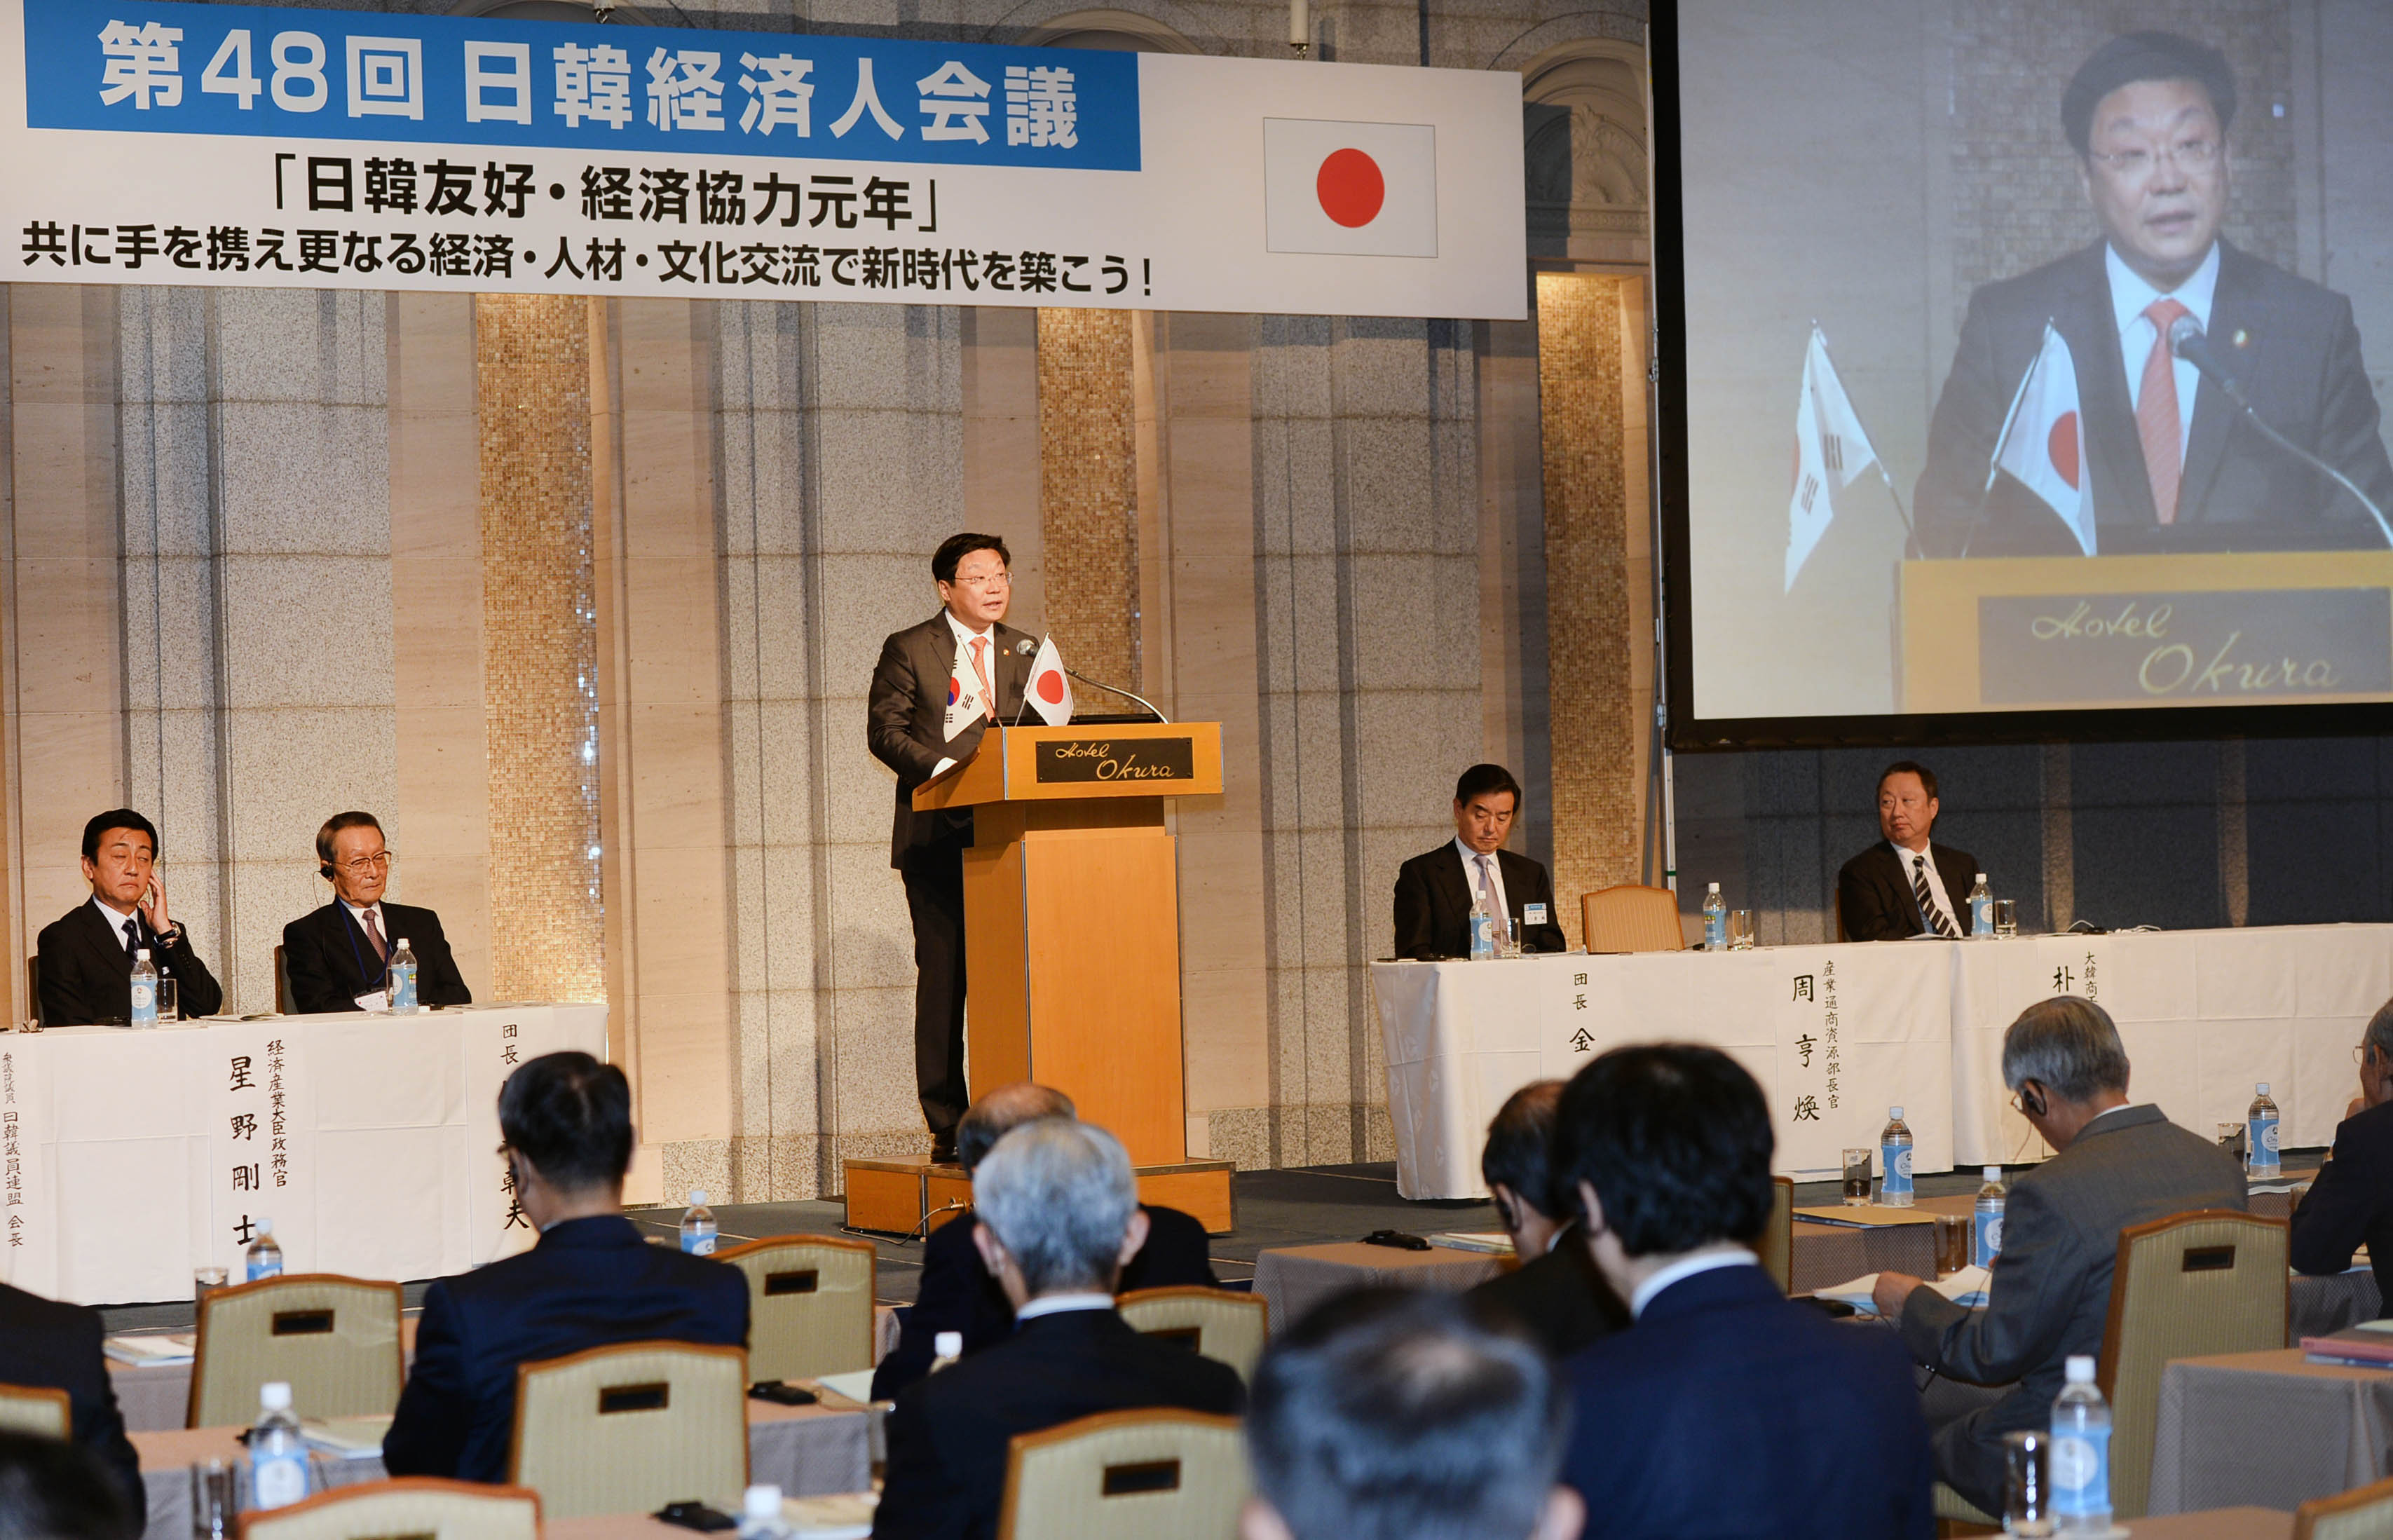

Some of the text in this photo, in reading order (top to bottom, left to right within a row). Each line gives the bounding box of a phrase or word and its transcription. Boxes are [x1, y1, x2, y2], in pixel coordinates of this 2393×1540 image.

[98, 20, 1078, 149] 第48回 日韓経済人会議
[275, 152, 937, 233] 「日韓友好・経済協力元年」
[2032, 600, 2172, 639] Hotel
[2139, 630, 2340, 695] Okura
[1055, 742, 1110, 758] Hotel
[1096, 754, 1175, 780] Okura
[1572, 972, 1588, 1010] 団長
[500, 1024, 519, 1065] 団長
[1822, 960, 1841, 1109] 産業通商資源部長官
[266, 1040, 288, 1187] 経済産業大臣政務官
[229, 1056, 259, 1246] 星野剛士
